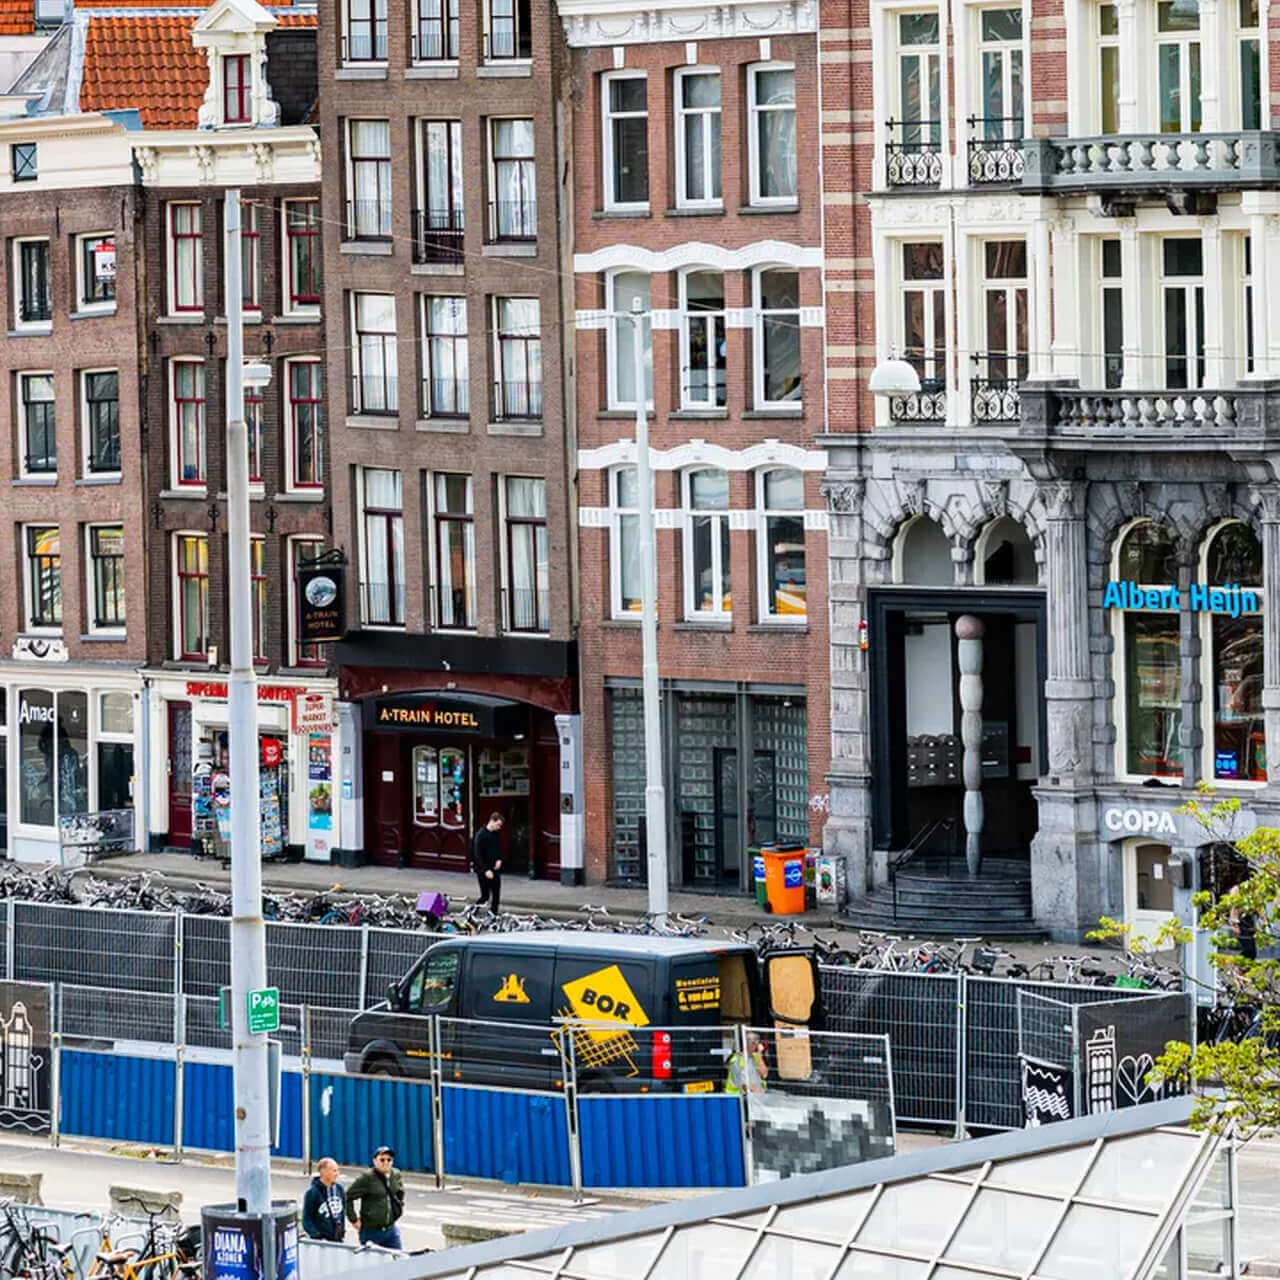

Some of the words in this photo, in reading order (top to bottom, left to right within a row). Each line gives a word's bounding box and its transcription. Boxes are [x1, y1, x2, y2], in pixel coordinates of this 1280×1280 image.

[1103, 581, 1181, 611] Albert
[1190, 584, 1258, 619] Heijn
[19, 699, 54, 724] Amac
[434, 710, 479, 727] HOTEL
[1104, 808, 1177, 834] COPA
[580, 987, 632, 1021] BOR
